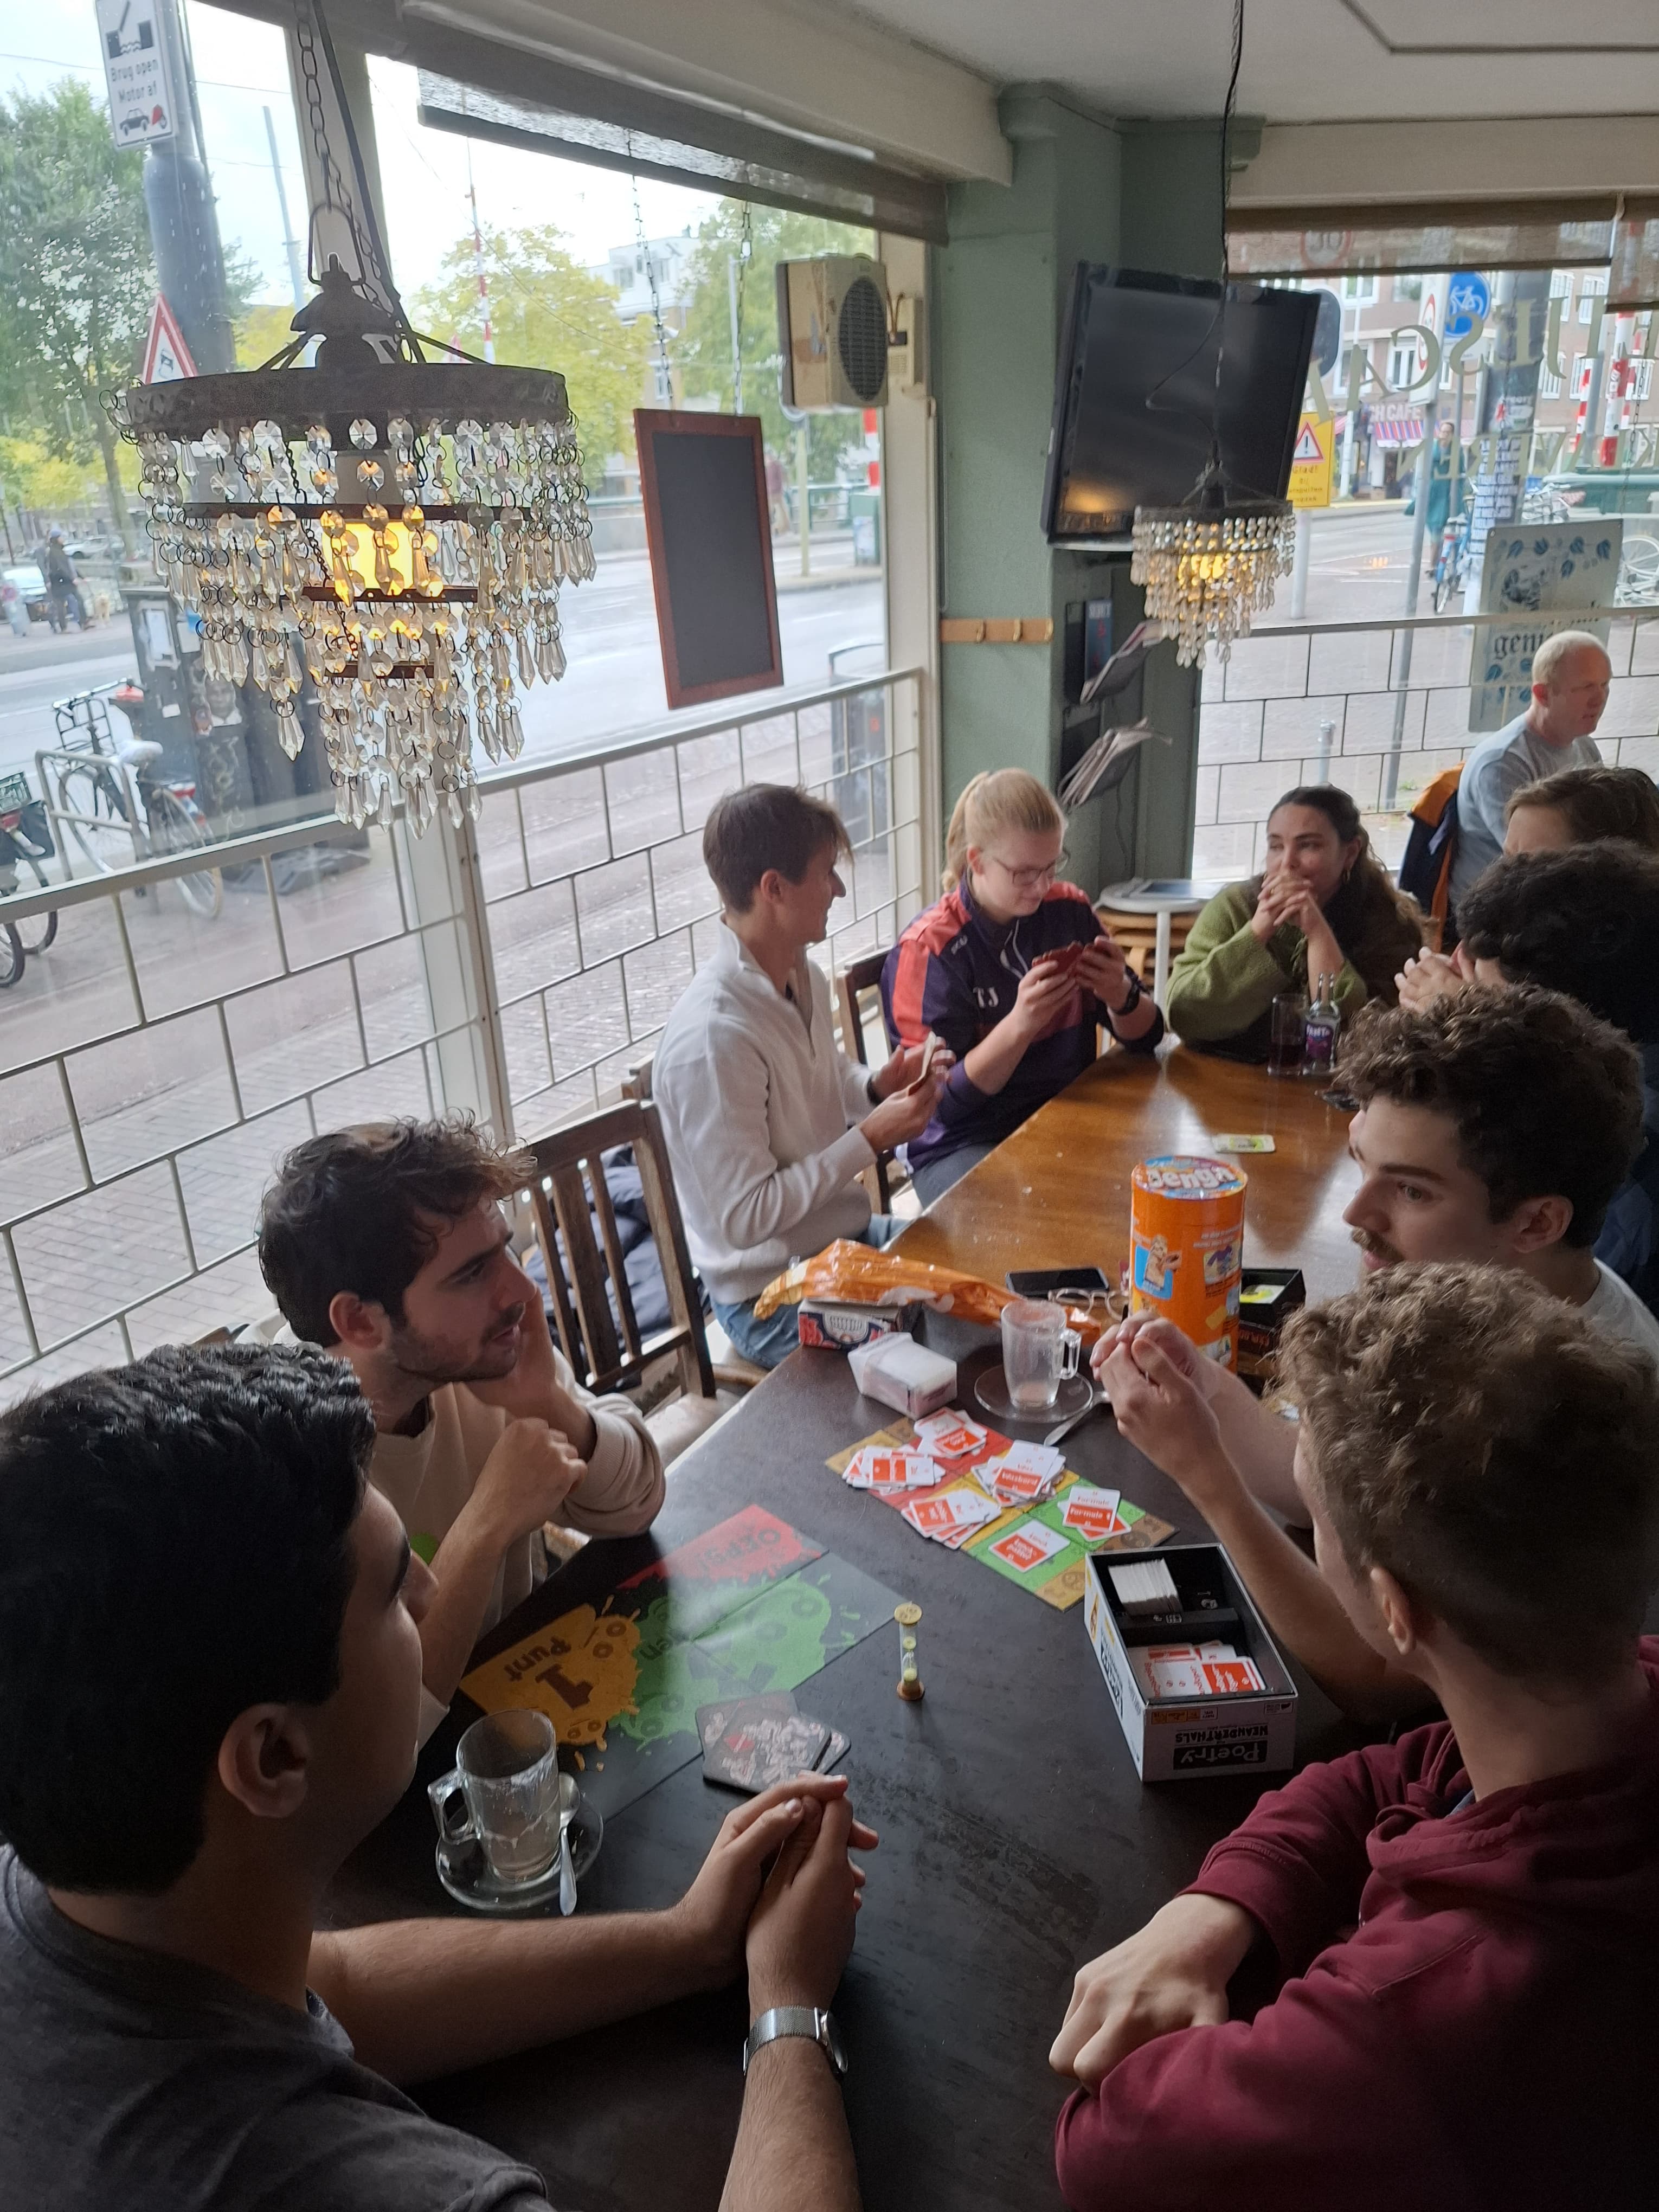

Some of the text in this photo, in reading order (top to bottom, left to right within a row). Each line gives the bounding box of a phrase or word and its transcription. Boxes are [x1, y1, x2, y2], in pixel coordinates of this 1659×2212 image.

[111, 59, 159, 82] Brug open
[119, 81, 157, 103] Motor af
[1175, 1725, 1268, 1744] NEANDERTHALS
[1181, 1744, 1259, 1764] Poetry
